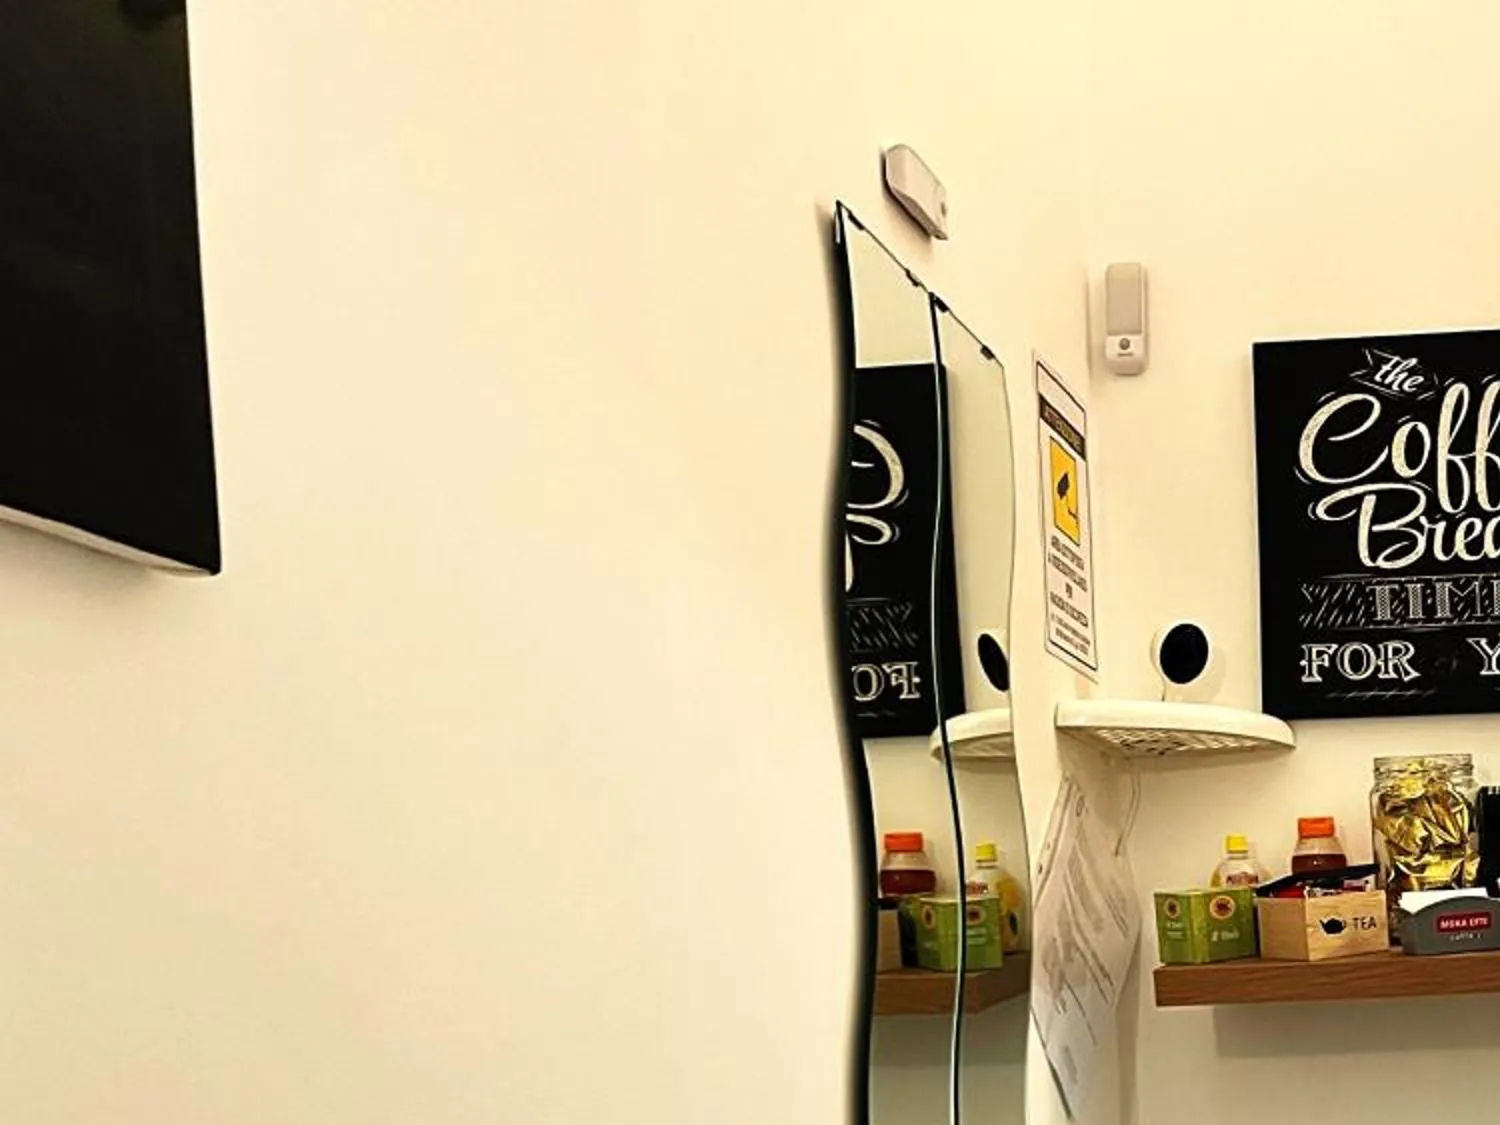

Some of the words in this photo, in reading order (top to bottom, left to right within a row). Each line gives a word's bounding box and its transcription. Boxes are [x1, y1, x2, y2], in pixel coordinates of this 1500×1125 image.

[1373, 354, 1424, 392] the
[1301, 638, 1421, 683] FOR
[1353, 915, 1377, 930] TEA
